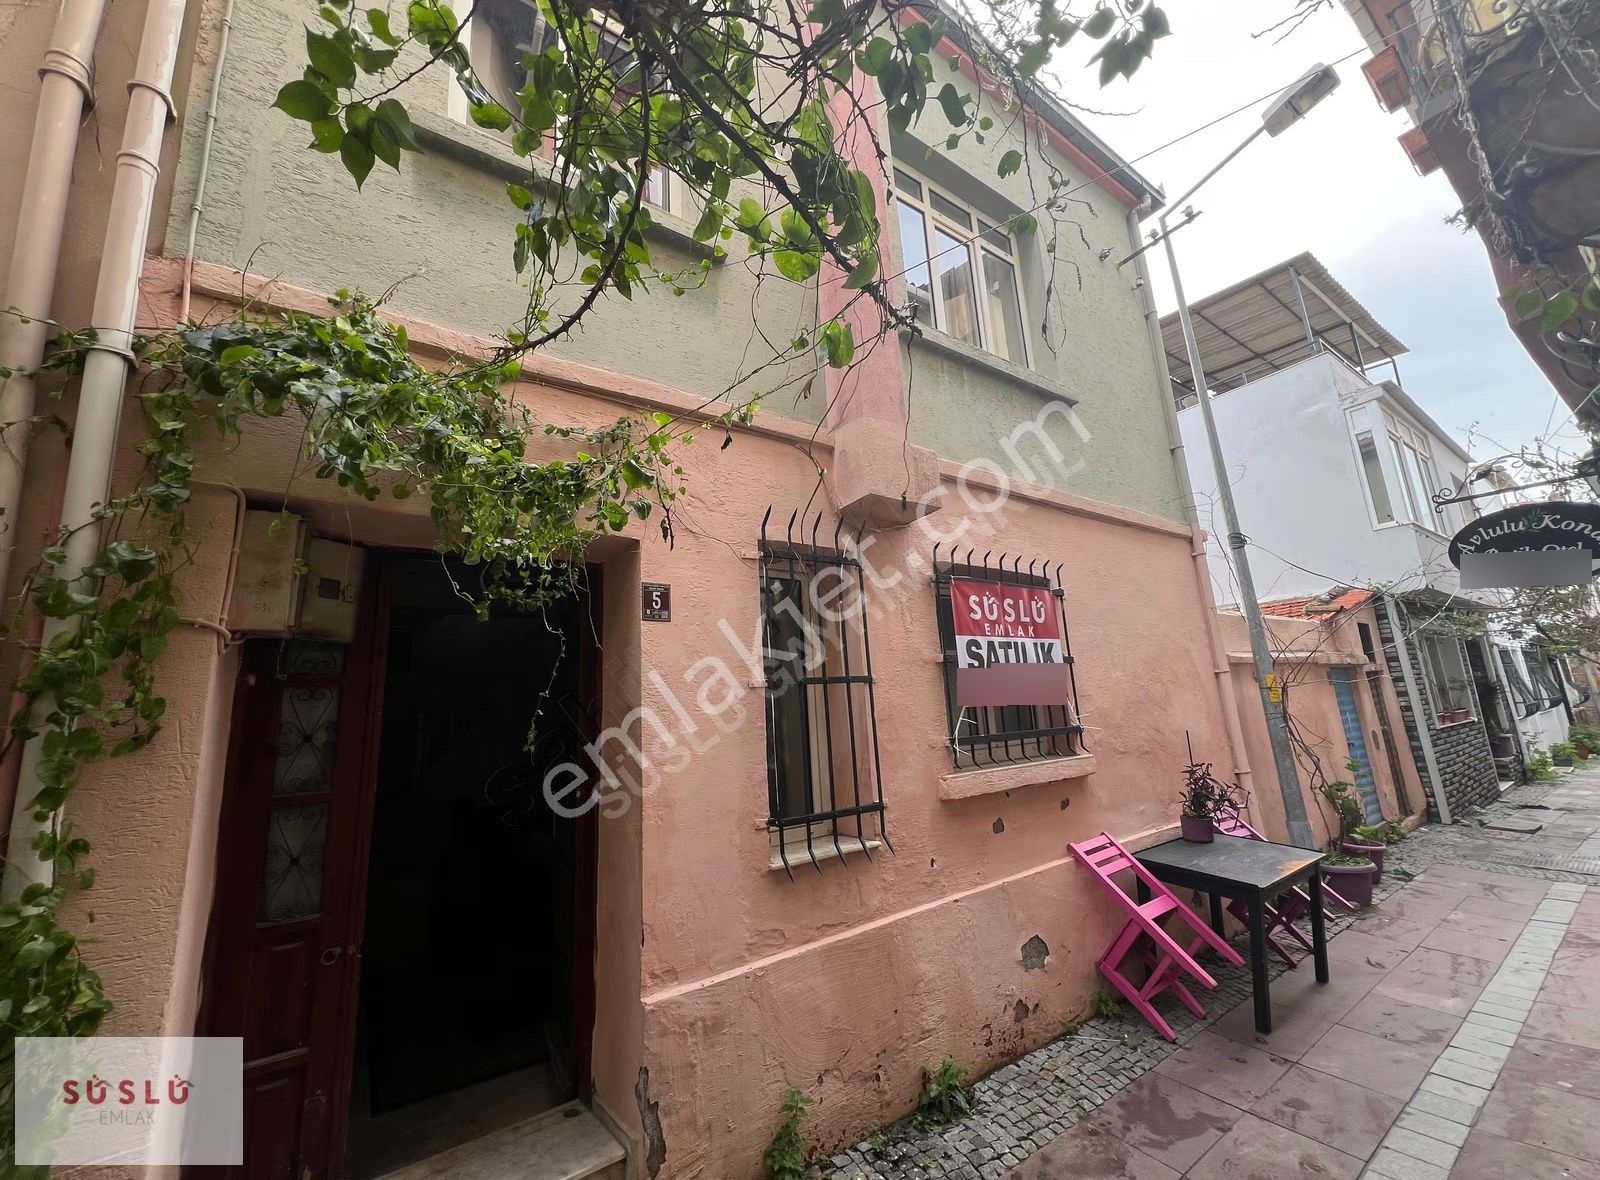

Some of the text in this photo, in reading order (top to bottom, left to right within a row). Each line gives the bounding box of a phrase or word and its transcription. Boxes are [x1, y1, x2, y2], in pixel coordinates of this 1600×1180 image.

[1457, 519, 1525, 554] Avlulu
[652, 591, 662, 609] 5
[984, 623, 1035, 637] EMLAK
